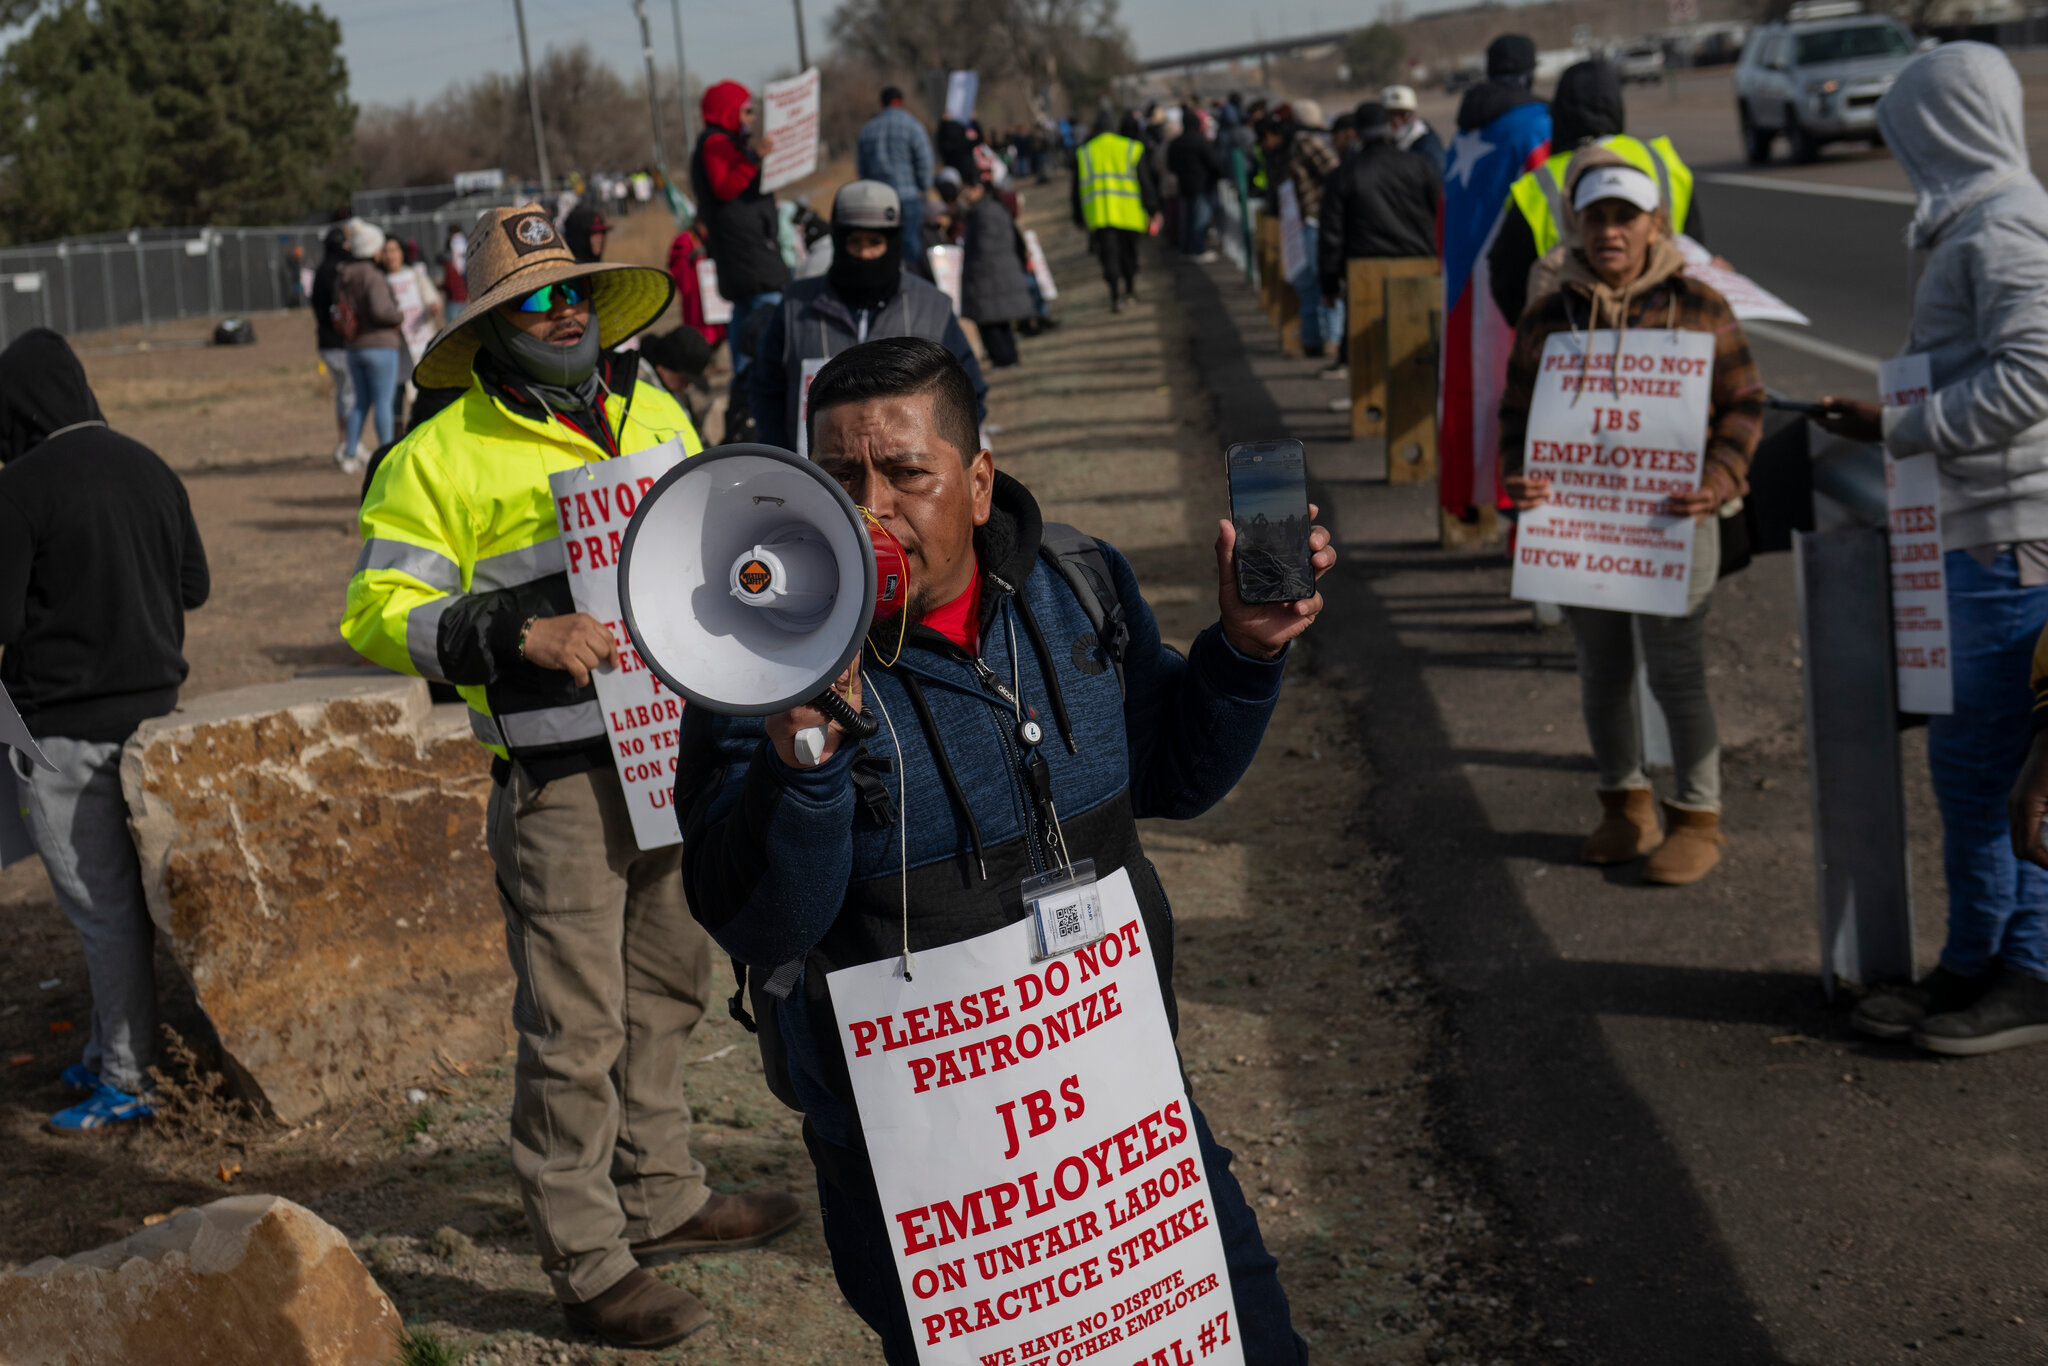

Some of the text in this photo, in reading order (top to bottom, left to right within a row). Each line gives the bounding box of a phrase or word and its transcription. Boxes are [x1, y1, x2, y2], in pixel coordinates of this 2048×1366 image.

[1621, 355, 1654, 372] DO
[1660, 356, 1707, 376] NOT
[1591, 407, 1641, 434] JBS
[1531, 441, 1697, 474] EMPLOYEES
[1529, 469, 1694, 496] ON UNFAIR LABOR
[1544, 491, 1621, 513] ACTICE
[566, 530, 622, 574] PRA
[1520, 547, 1686, 581] UFCW LOCAL #7
[610, 697, 687, 732] LABOR
[618, 738, 644, 758] NO
[624, 760, 662, 783] CON
[849, 985, 1010, 1057] PLEASE
[1014, 961, 1069, 1012] DO
[1074, 920, 1141, 983] NOT
[908, 982, 1122, 1093] PATRONIZE
[995, 1074, 1086, 1160] JBS
[896, 1100, 1187, 1256] EMPLOYEES
[912, 1157, 1200, 1299] ON UNFAIR LABOR
[922, 1199, 1209, 1345] PRACTICE STRIKE
[980, 1269, 1184, 1366] WE HAVE NO DISPUTE
[1056, 1273, 1219, 1366] OTHER EMPLOYER
[1198, 1311, 1231, 1358] #7
